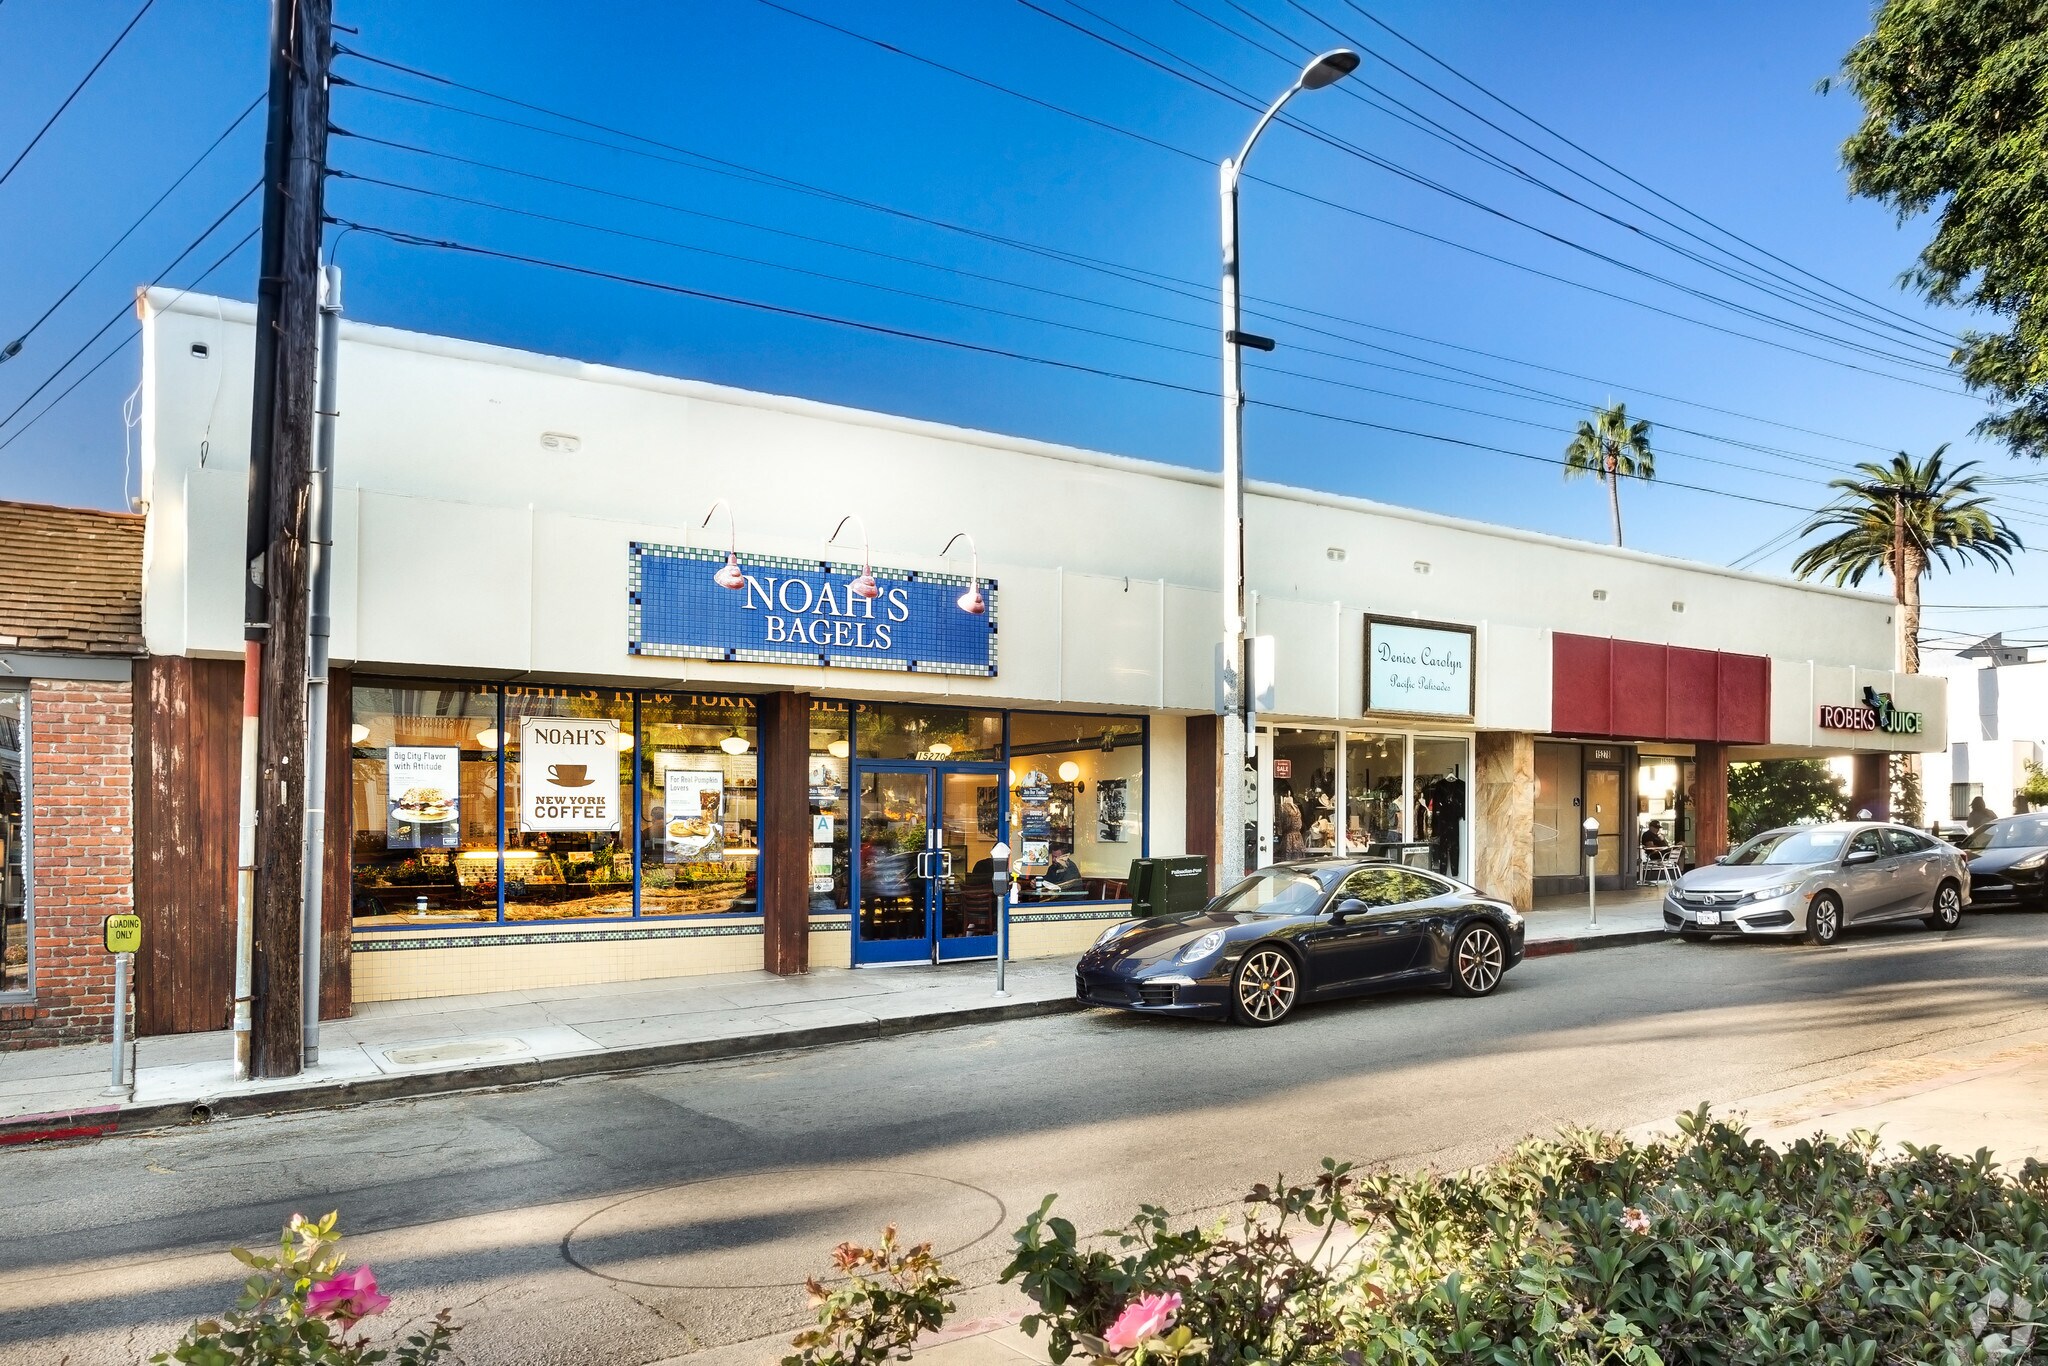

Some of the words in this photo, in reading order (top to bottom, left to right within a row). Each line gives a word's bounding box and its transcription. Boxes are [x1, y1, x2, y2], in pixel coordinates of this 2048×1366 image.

[742, 574, 910, 622] NOAH'S
[764, 615, 892, 650] BAGELS
[1378, 642, 1417, 665] Denise
[1421, 646, 1462, 675] Carolyn
[1390, 673, 1415, 693] Pacific
[1418, 676, 1451, 692] Palisades
[1825, 705, 1876, 731] ROBEKS
[1887, 711, 1923, 733] JUICE
[534, 728, 607, 746] NOAH'S
[394, 751, 406, 761] Big
[407, 752, 422, 761] City
[423, 752, 447, 760] Flavor
[917, 752, 946, 761] 15270
[413, 763, 442, 771] Attitude
[694, 777, 718, 785] Pumpkin
[535, 796, 567, 805] NEW
[569, 796, 606, 805] YORK
[534, 806, 606, 819] COFFEE
[817, 816, 829, 830] A
[110, 919, 139, 928] LOADING
[116, 930, 133, 939] ONLY
